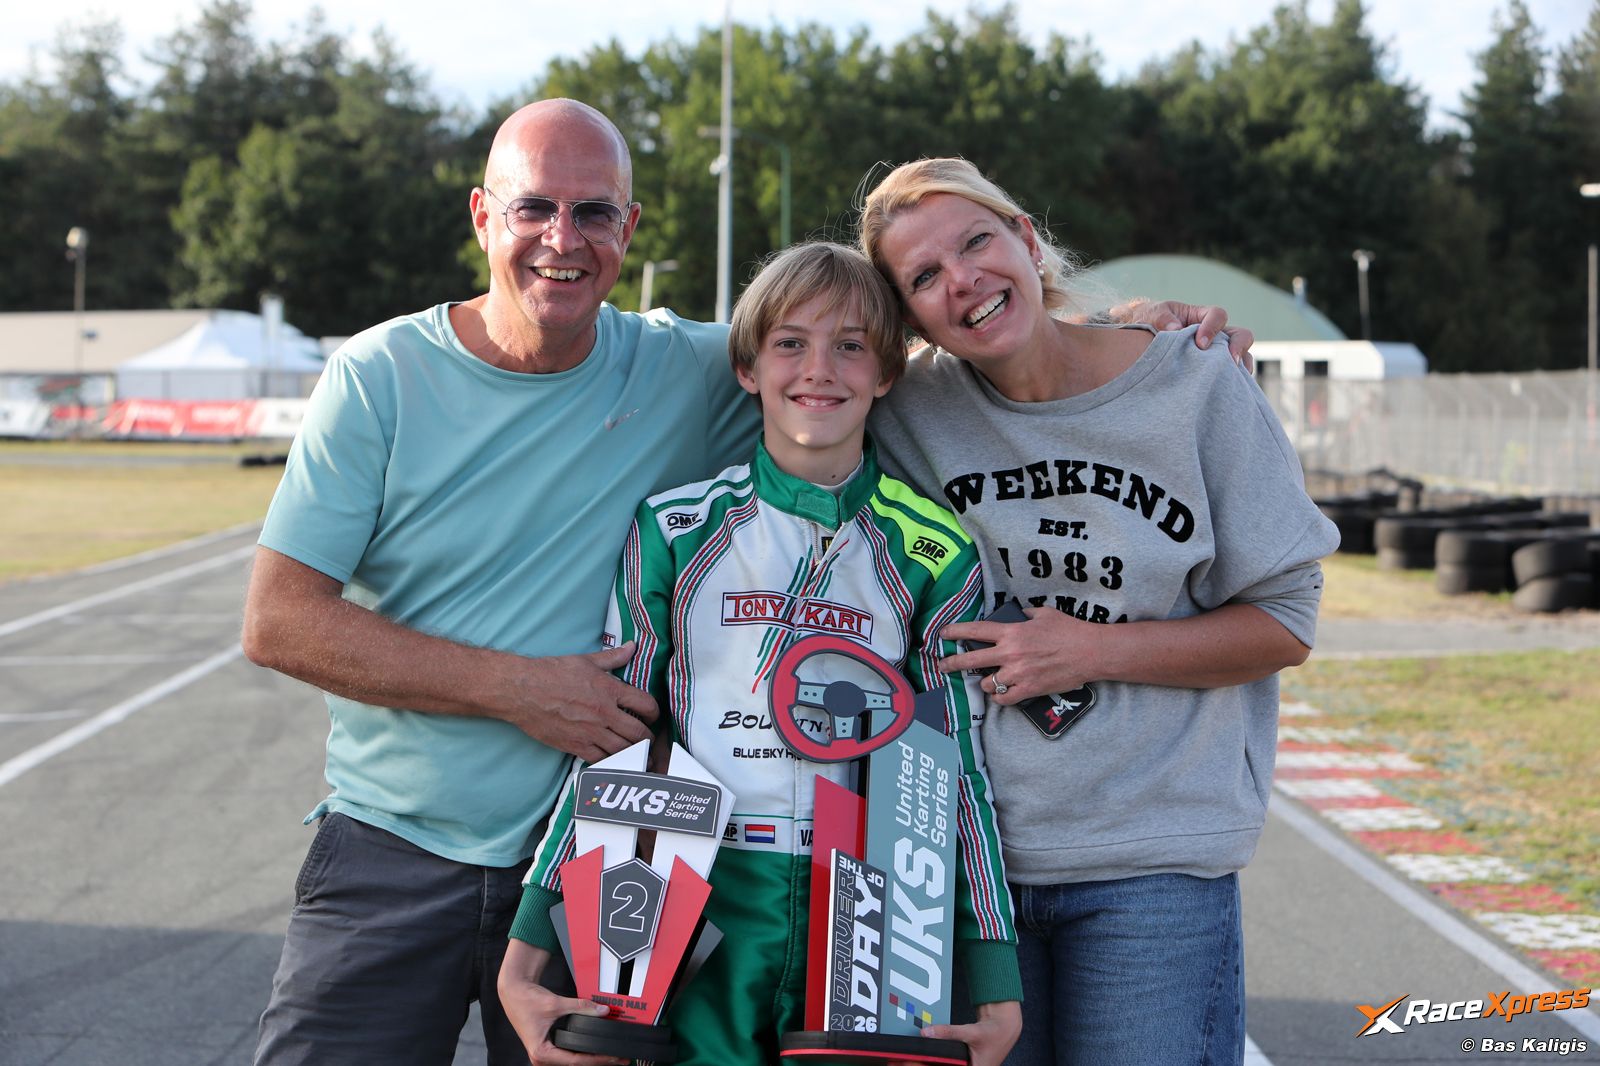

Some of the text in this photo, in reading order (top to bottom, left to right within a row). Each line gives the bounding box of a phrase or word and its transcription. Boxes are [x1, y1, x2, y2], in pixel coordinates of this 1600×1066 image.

[943, 459, 1195, 543] WEEKEND
[1038, 518, 1088, 540] EST.
[912, 538, 946, 560] OMP
[730, 594, 865, 633] TONY KART
[733, 747, 761, 758] BLUE
[762, 748, 784, 758] SKY
[599, 783, 671, 815] UKS
[674, 792, 712, 805] United
[895, 740, 914, 828] United
[914, 752, 935, 838] Karting
[664, 808, 700, 821] Series
[669, 800, 706, 814] Karting
[930, 767, 949, 848] Series
[838, 855, 884, 888] OF THE
[608, 880, 648, 933] 2
[889, 836, 946, 1006] UKS
[833, 868, 855, 1006] DRIVER
[850, 876, 882, 1016] DAY
[830, 1012, 878, 1033] 2026
